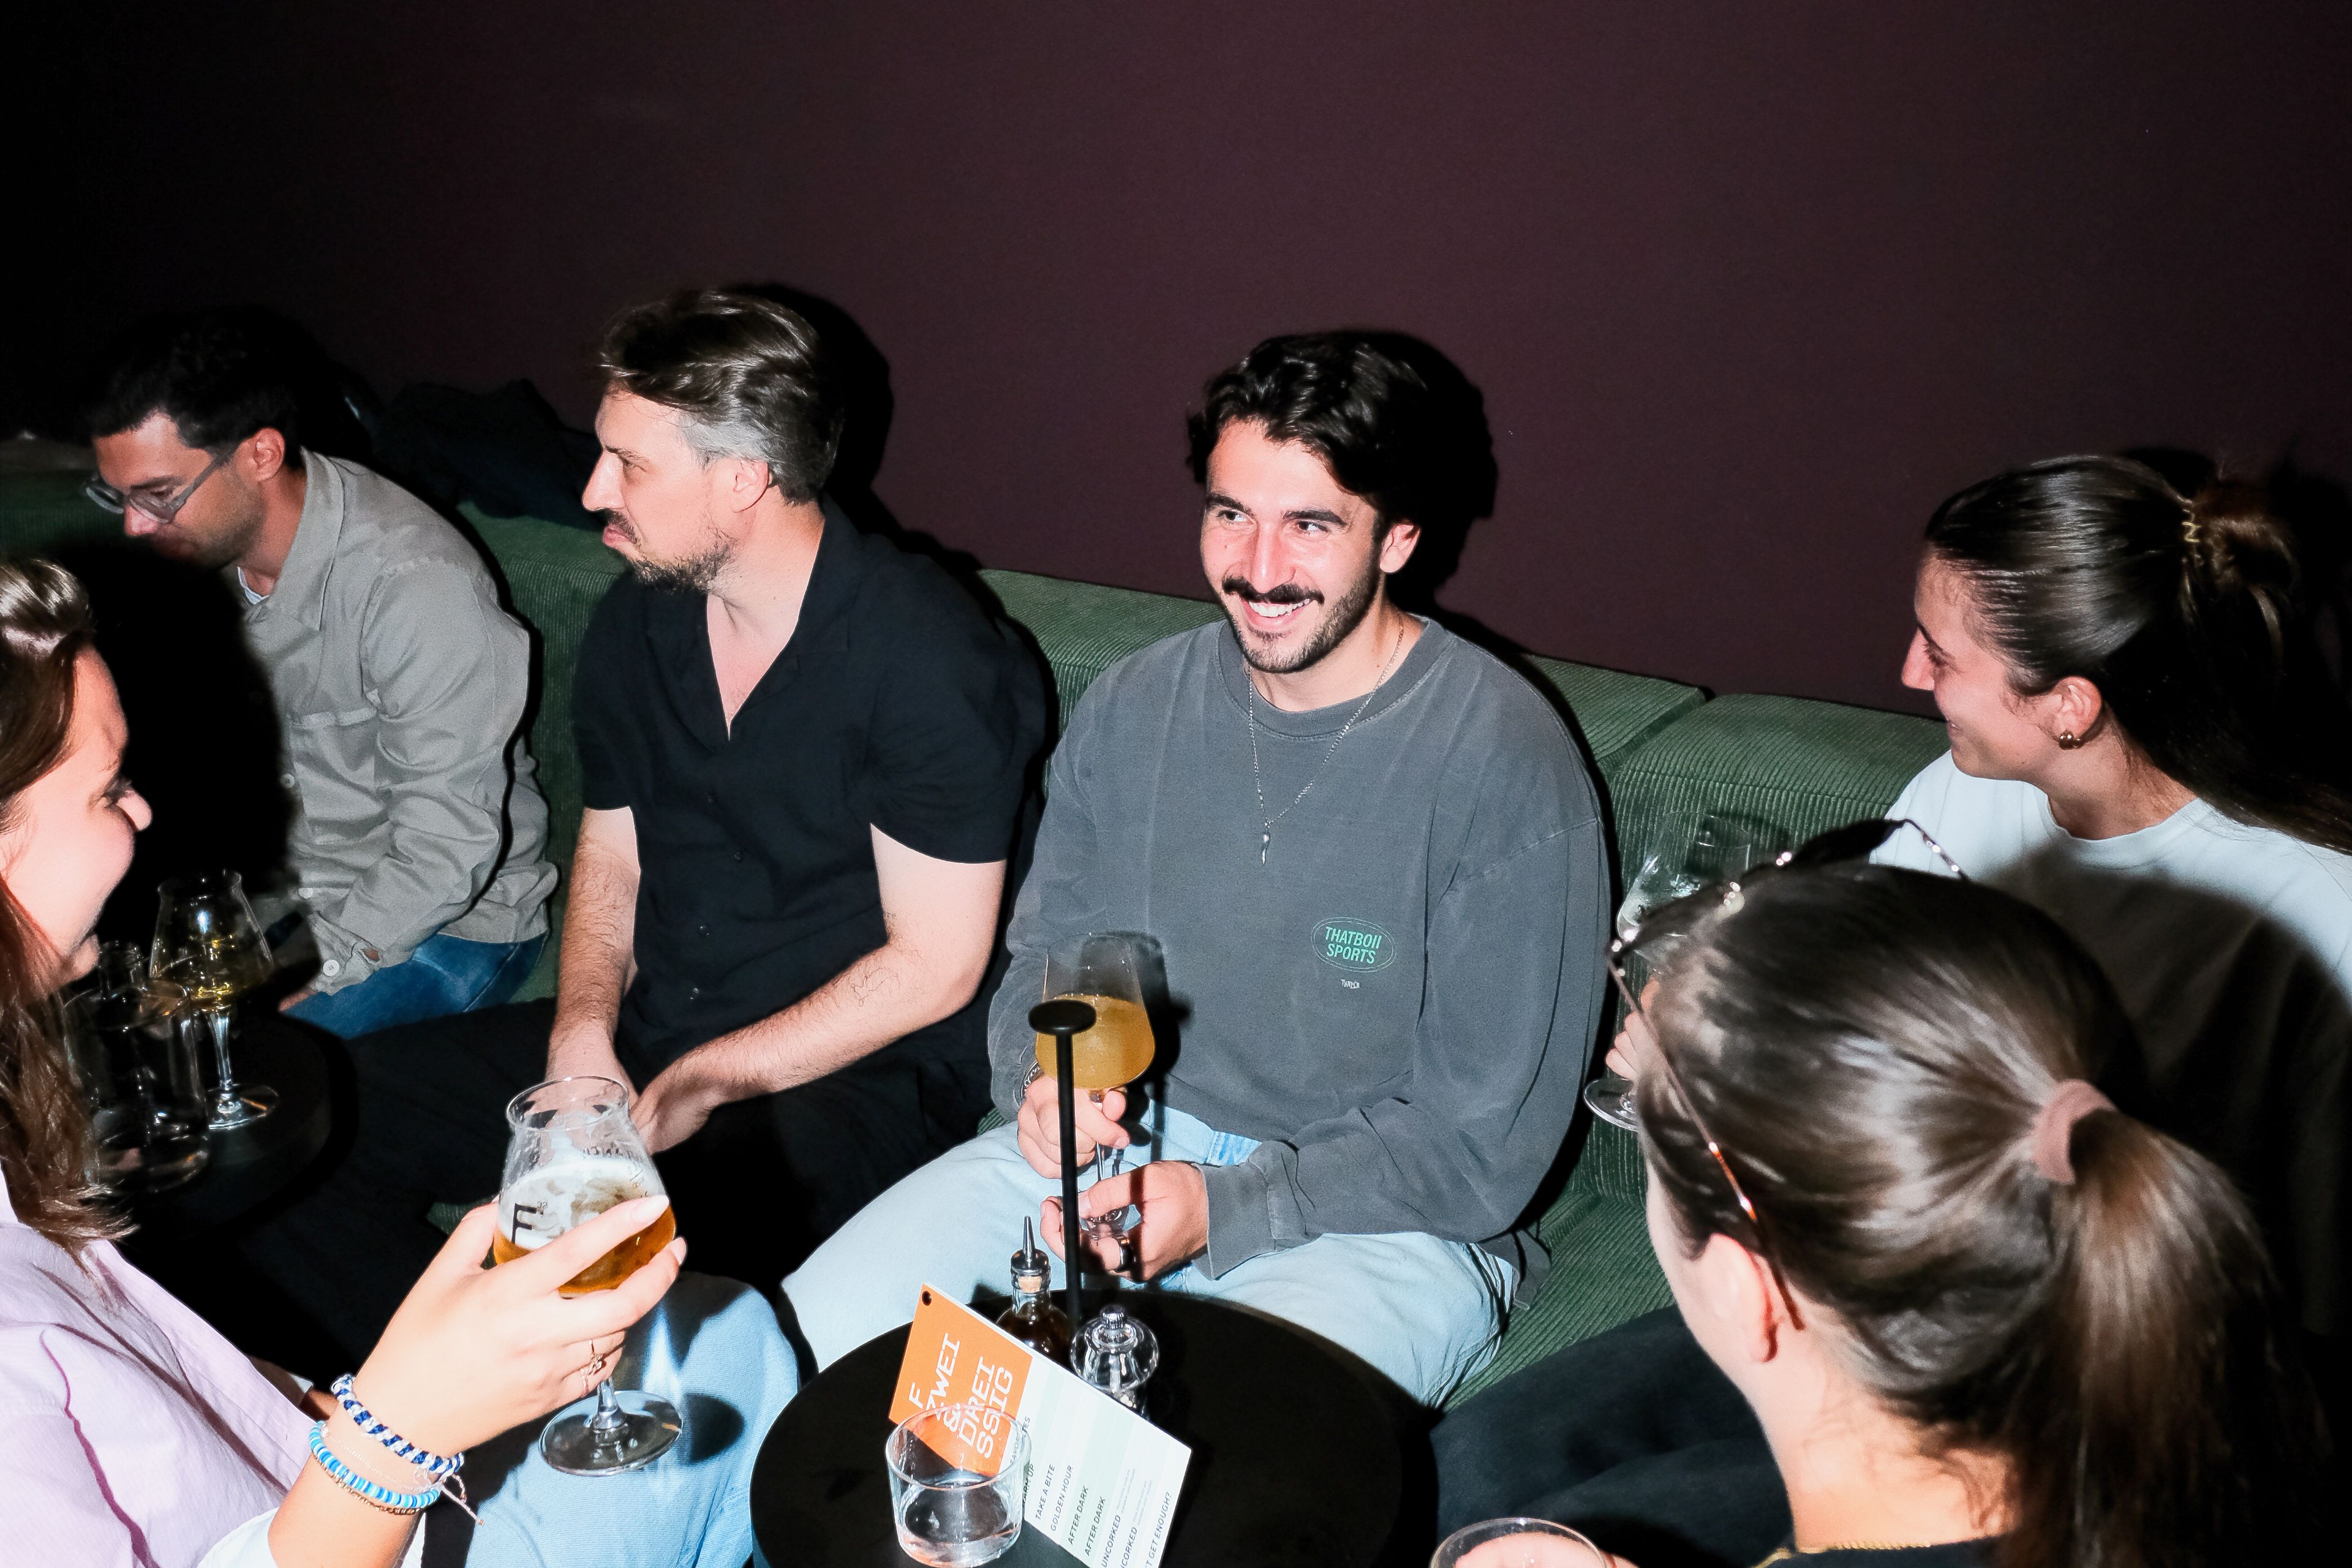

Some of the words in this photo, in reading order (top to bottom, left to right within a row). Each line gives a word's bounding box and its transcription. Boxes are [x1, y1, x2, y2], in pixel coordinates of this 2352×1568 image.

[1325, 926, 1382, 949] THATBOII
[1326, 943, 1376, 964] SPORTS
[908, 1382, 923, 1409] F
[925, 1333, 960, 1421] ZWEI
[976, 1366, 1012, 1459] SSIG
[1027, 1463, 1035, 1477] UP
[1035, 1496, 1047, 1520] TAKE
[1045, 1463, 1055, 1487] BITE
[1050, 1494, 1065, 1531] GOLDEN
[1062, 1464, 1073, 1493] HOUR
[1068, 1513, 1082, 1545] AFTER
[1077, 1485, 1089, 1513] DARK
[1084, 1525, 1098, 1556] AFTER
[1093, 1496, 1106, 1524] DARK
[1101, 1515, 1121, 1568] UNCORKED
[1148, 1541, 1158, 1559] GET
[1154, 1491, 1172, 1539] ENOUGH?
